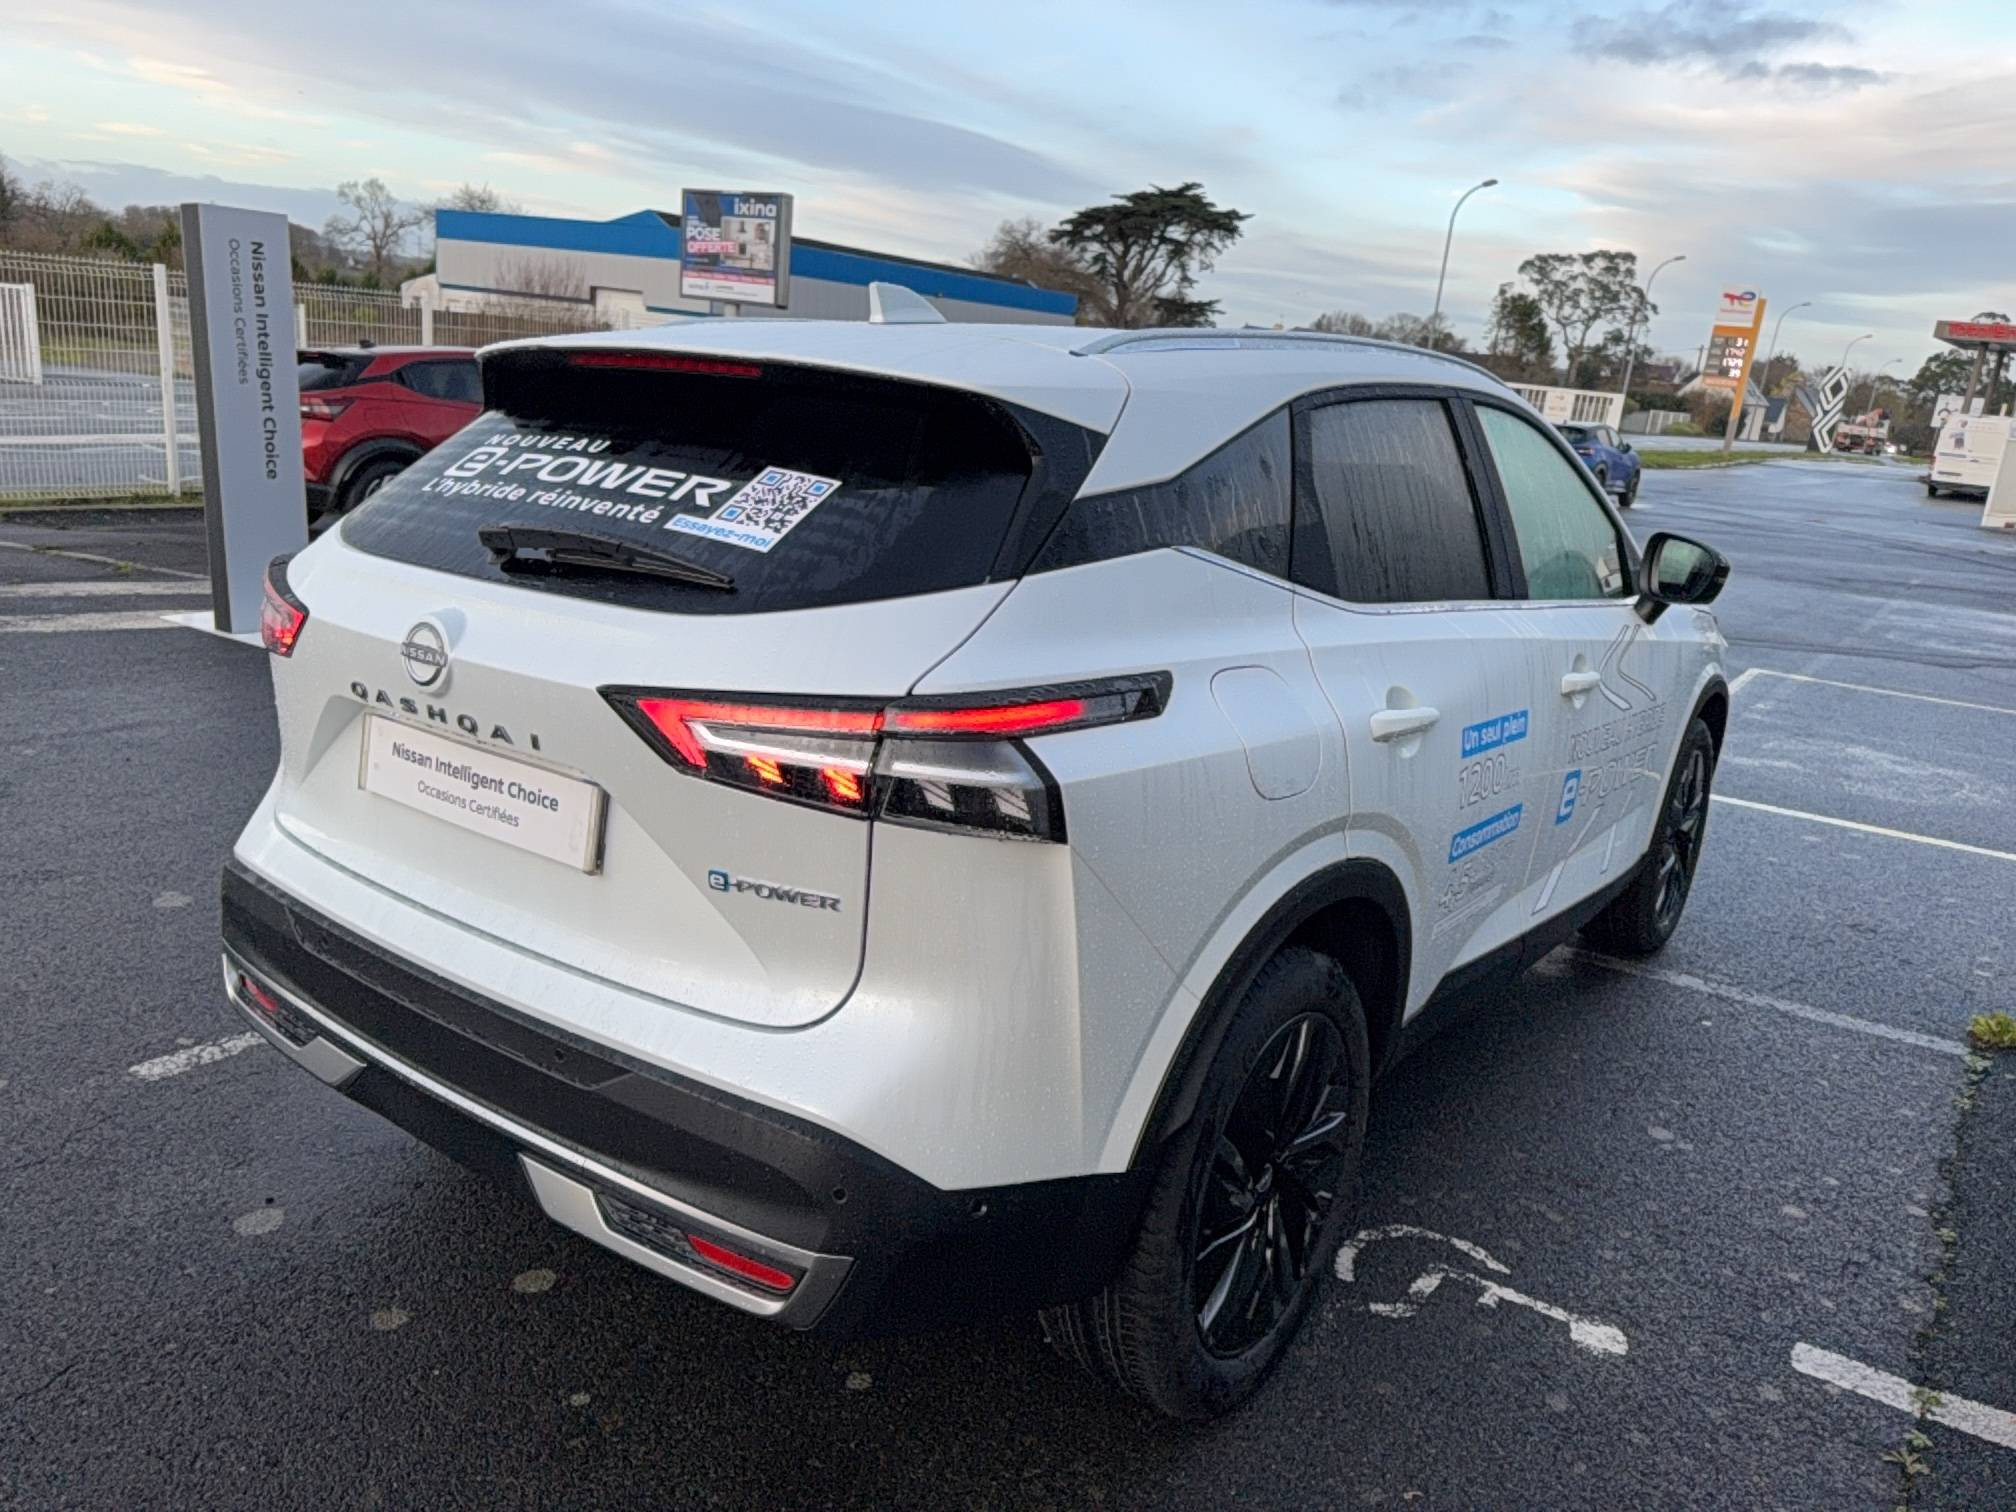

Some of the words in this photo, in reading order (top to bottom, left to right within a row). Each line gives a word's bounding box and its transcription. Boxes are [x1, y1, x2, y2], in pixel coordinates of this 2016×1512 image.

[686, 226, 721, 240] POSE
[228, 238, 243, 313] Occasions
[251, 241, 265, 308] Nissan
[234, 317, 249, 385] Certifiées
[256, 313, 275, 412] Intelligent
[263, 416, 277, 480] Choice
[484, 432, 611, 454] NOUVEAU
[422, 477, 524, 502] L'hybride
[530, 486, 665, 524] réinventé
[672, 517, 773, 548] Essayez-moi
[401, 642, 447, 666] NISSAN
[351, 681, 541, 750] QASHQAI
[1463, 728, 1479, 751] Un
[1481, 719, 1501, 745] seul
[1502, 715, 1525, 743] plein
[392, 741, 433, 770] Nissan
[435, 757, 504, 794] Intelligent
[507, 781, 559, 811] Choice
[417, 780, 467, 809] Occasions
[469, 799, 519, 827] Certifiées
